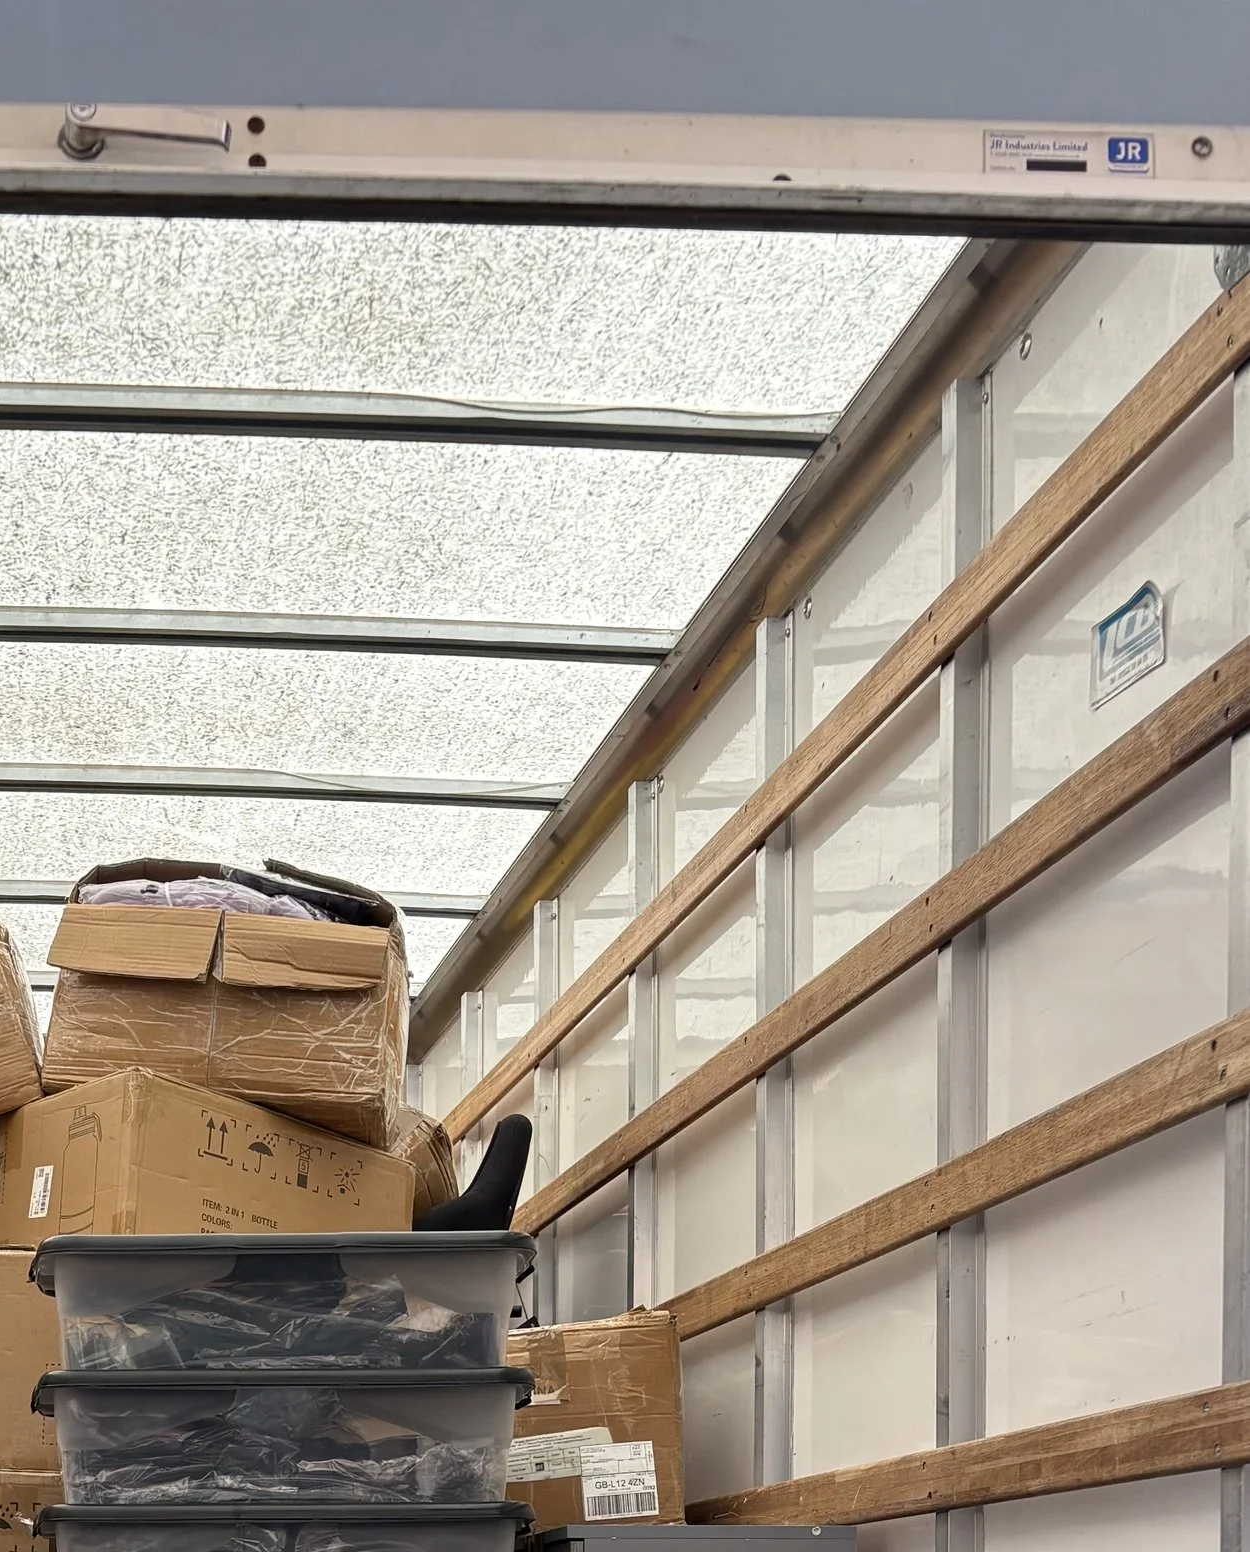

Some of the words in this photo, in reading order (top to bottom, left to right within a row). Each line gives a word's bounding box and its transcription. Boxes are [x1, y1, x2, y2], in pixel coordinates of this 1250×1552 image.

[1052, 142, 1088, 151] Limited
[1115, 141, 1142, 160] JR
[201, 1213, 233, 1230] COLORS:
[202, 1198, 223, 1211] ITEM:
[225, 1206, 230, 1214] 2
[231, 1207, 240, 1217] IN
[251, 1214, 278, 1230] BOTTLE
